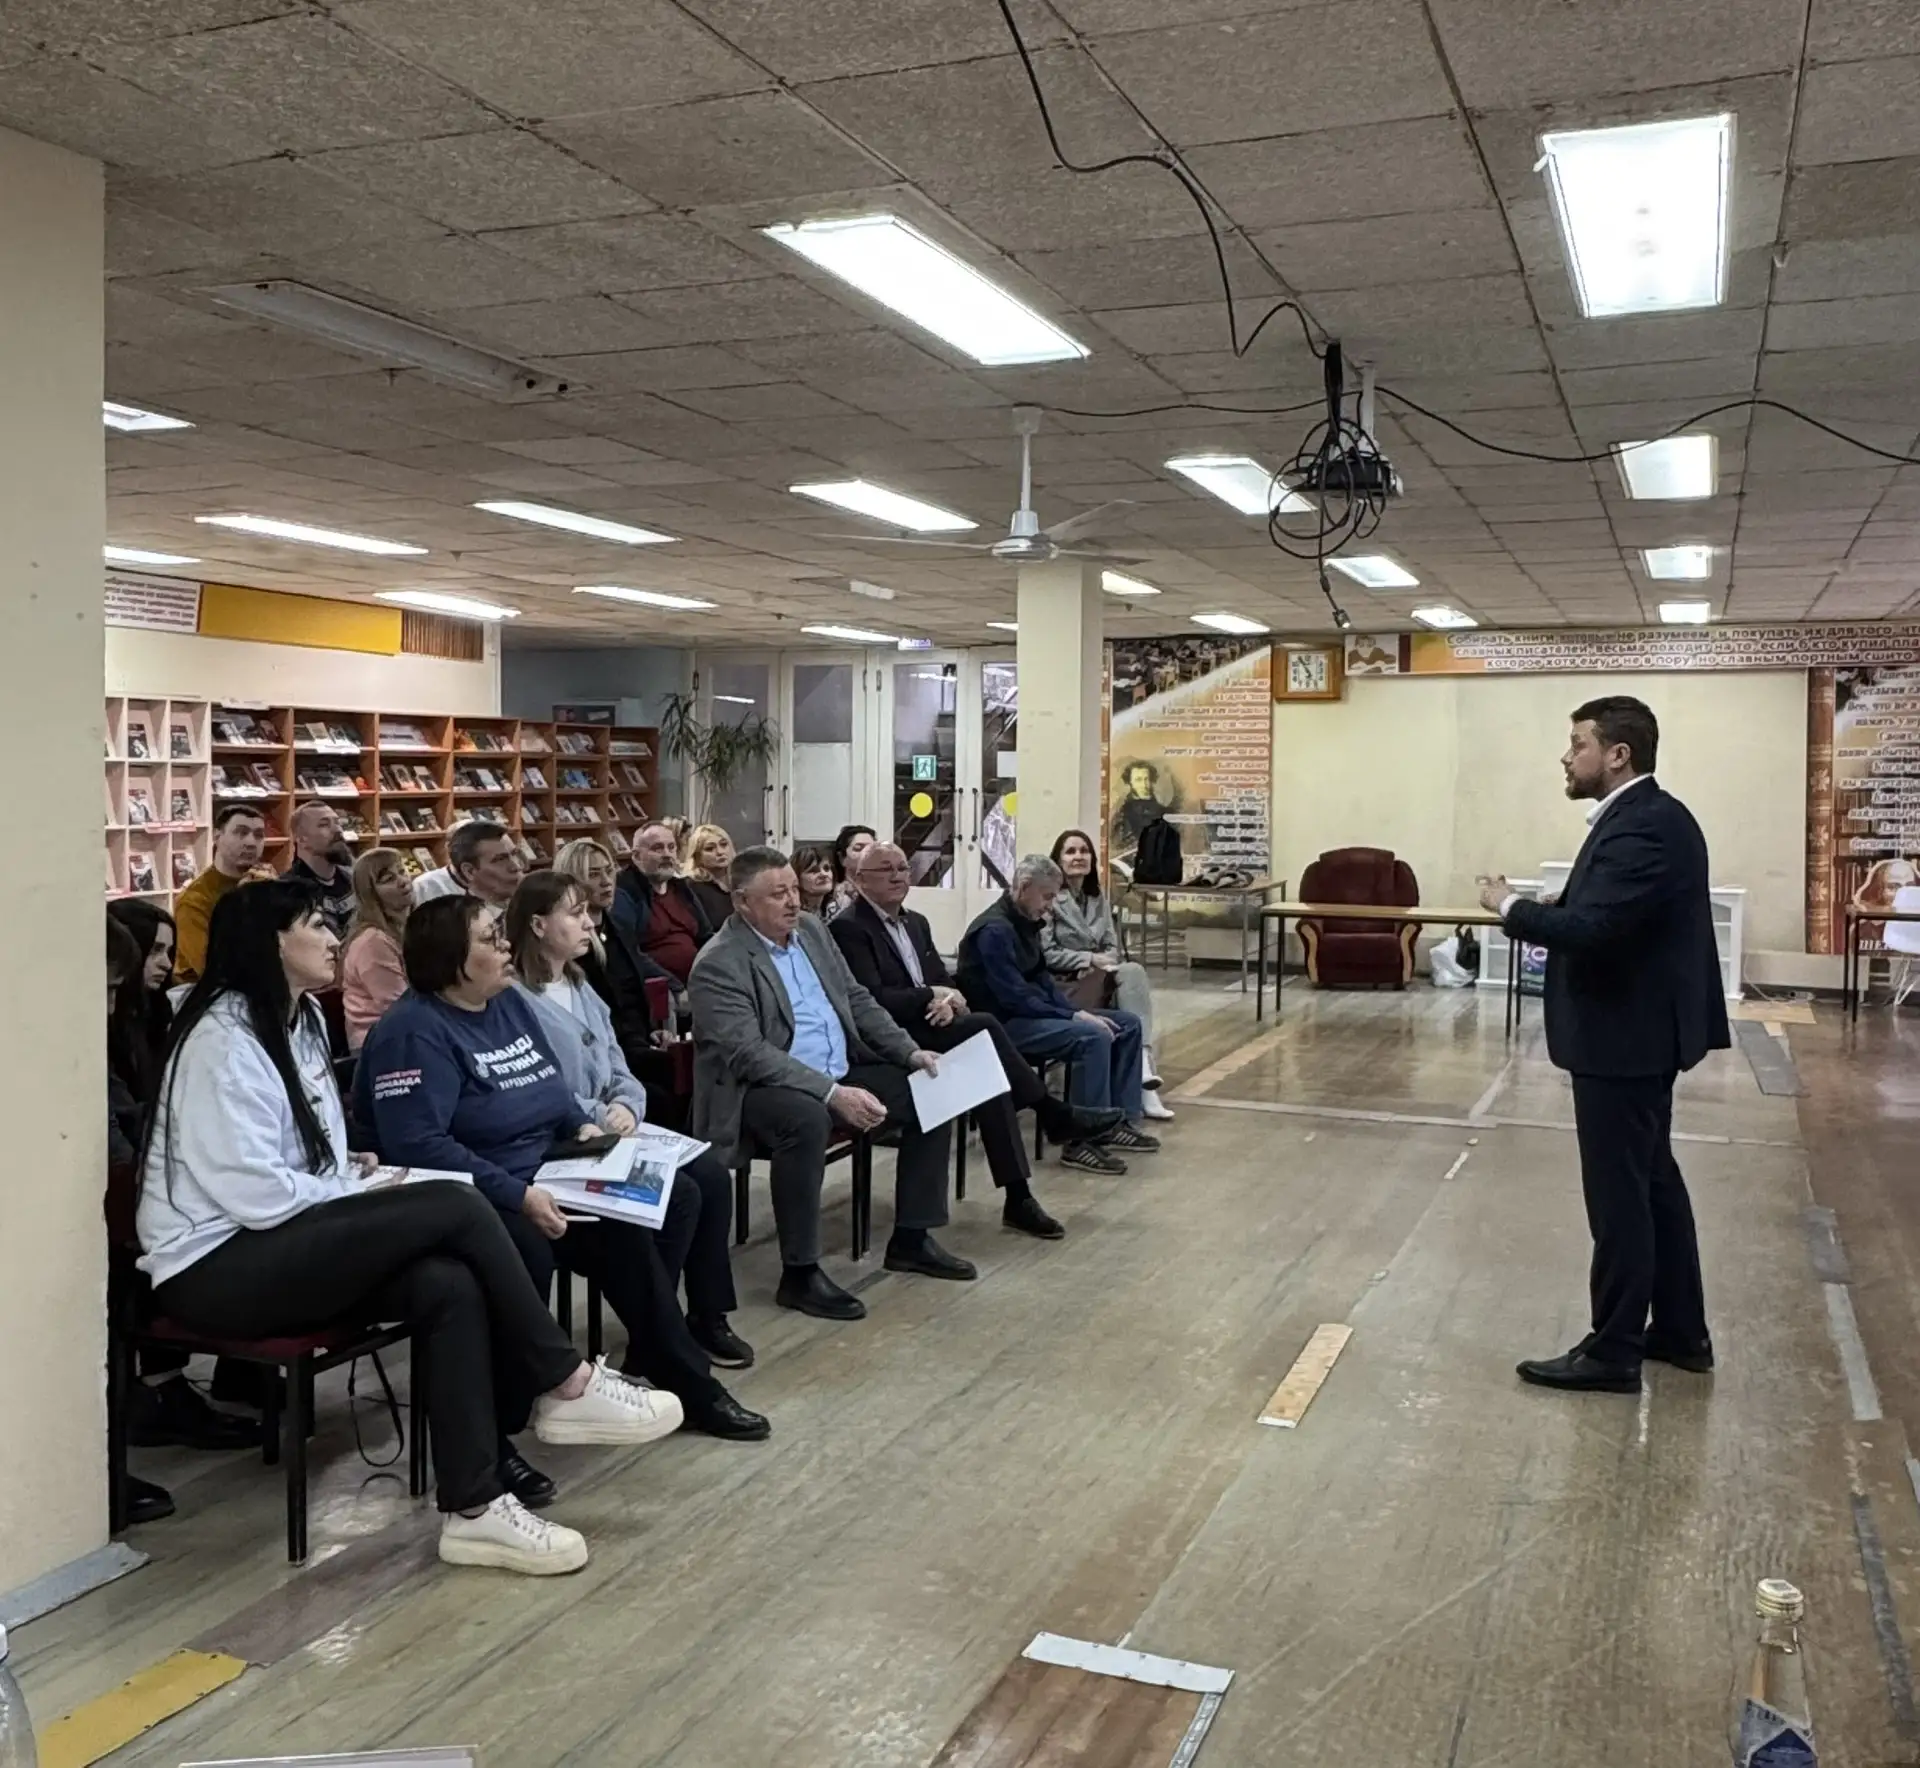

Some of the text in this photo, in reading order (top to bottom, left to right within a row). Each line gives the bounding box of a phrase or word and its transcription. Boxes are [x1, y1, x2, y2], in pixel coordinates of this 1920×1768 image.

[1447, 633, 1512, 645] Собирать
[1617, 632, 1635, 641] не
[1732, 629, 1800, 640] покупать
[1805, 627, 1821, 636] их
[1827, 627, 1854, 637] для
[1456, 647, 1512, 655] славных
[1595, 644, 1645, 653] весьма
[1650, 643, 1710, 653] походит
[1761, 641, 1794, 649] если
[1812, 640, 1837, 649] кто
[1842, 639, 1887, 651] купил
[1488, 659, 1543, 669] которое
[1547, 658, 1576, 667] хотя
[1580, 657, 1607, 667] ему
[1623, 657, 1640, 665] не
[1699, 656, 1716, 664] но
[1721, 654, 1786, 664] славным
[1792, 652, 1860, 664] портным
[490, 1050, 544, 1075] ПУТИНА
[374, 1076, 422, 1091] КОМАНДА
[375, 1086, 410, 1100] ПУТИНА
